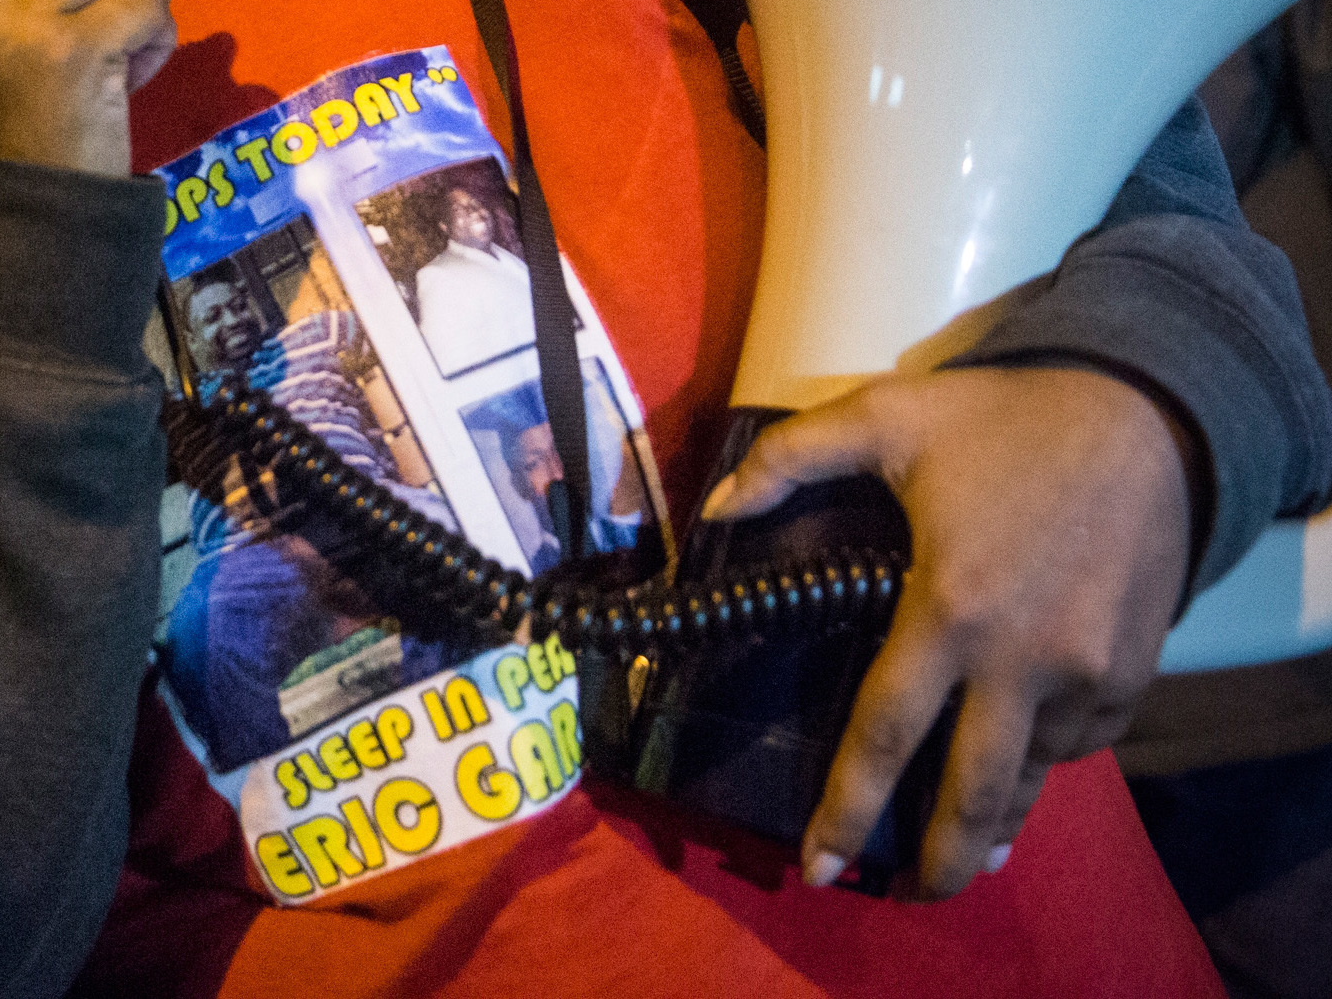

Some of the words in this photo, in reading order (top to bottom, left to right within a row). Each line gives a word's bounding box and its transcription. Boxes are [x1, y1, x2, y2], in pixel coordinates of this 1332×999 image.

[274, 704, 414, 809] SLEEP
[421, 674, 491, 741] IN
[255, 775, 442, 899] ERIC
